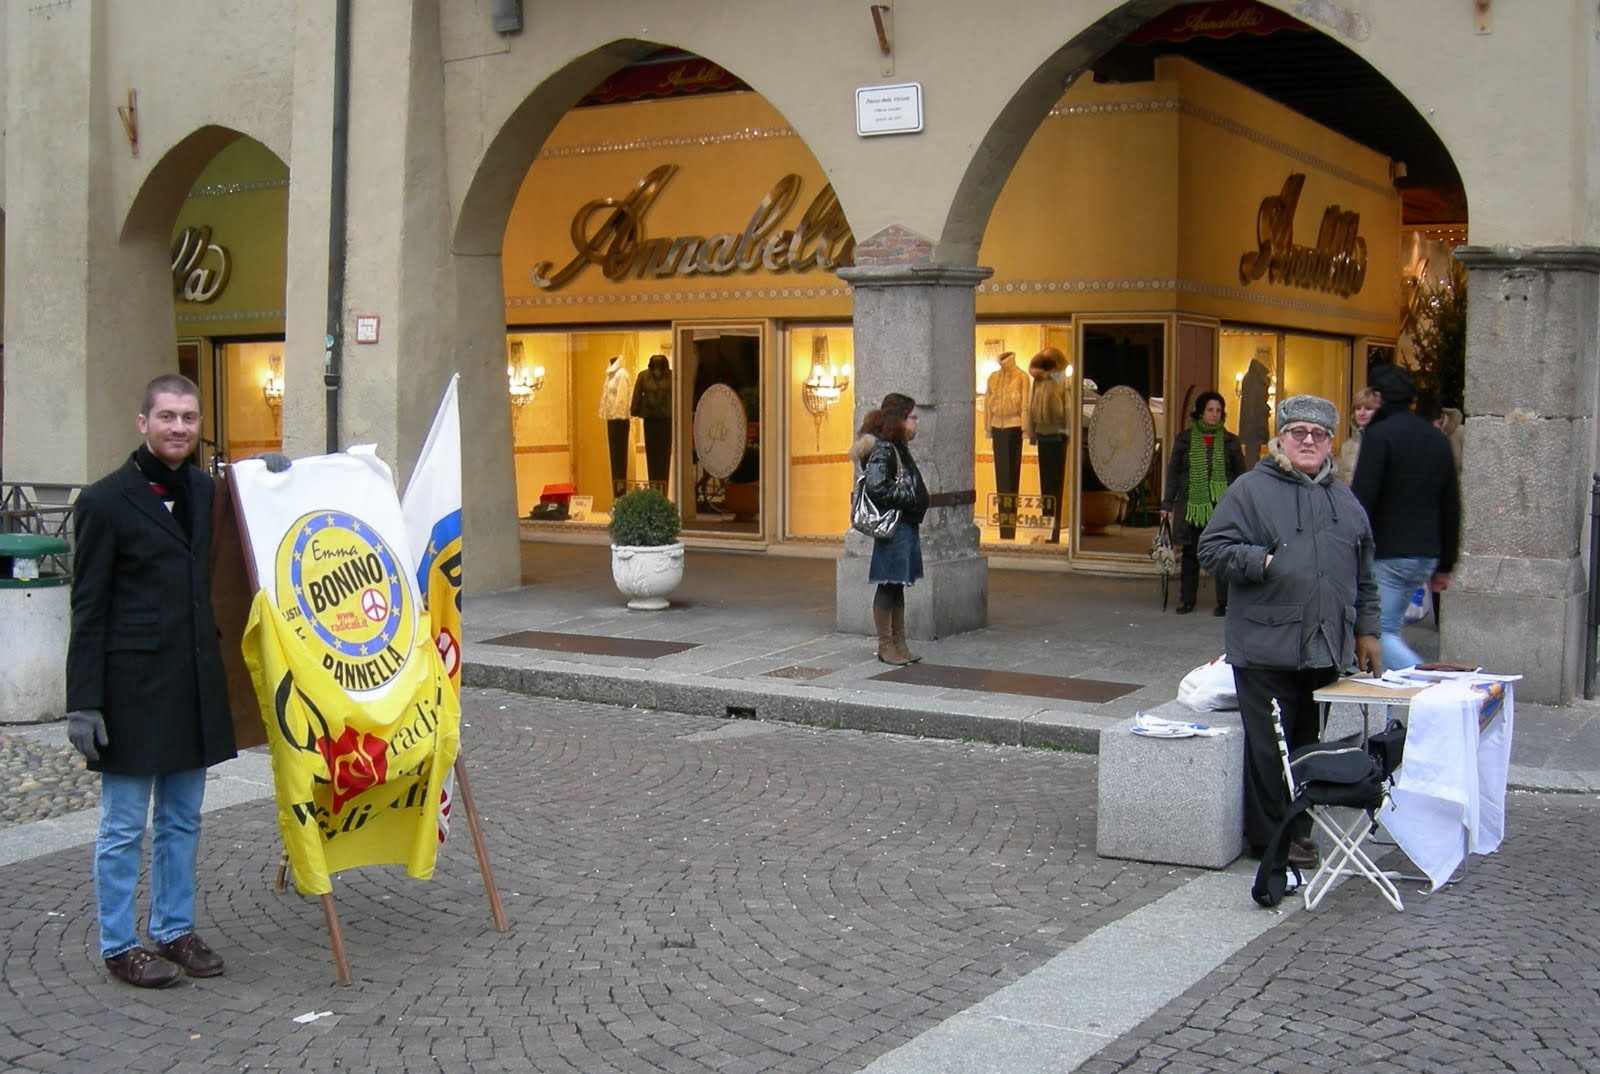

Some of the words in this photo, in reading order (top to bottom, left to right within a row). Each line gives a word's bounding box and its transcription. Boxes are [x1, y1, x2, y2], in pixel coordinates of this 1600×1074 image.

[992, 496, 1052, 510] PREZZI
[312, 539, 358, 561] Emma
[309, 552, 384, 614] BONINO
